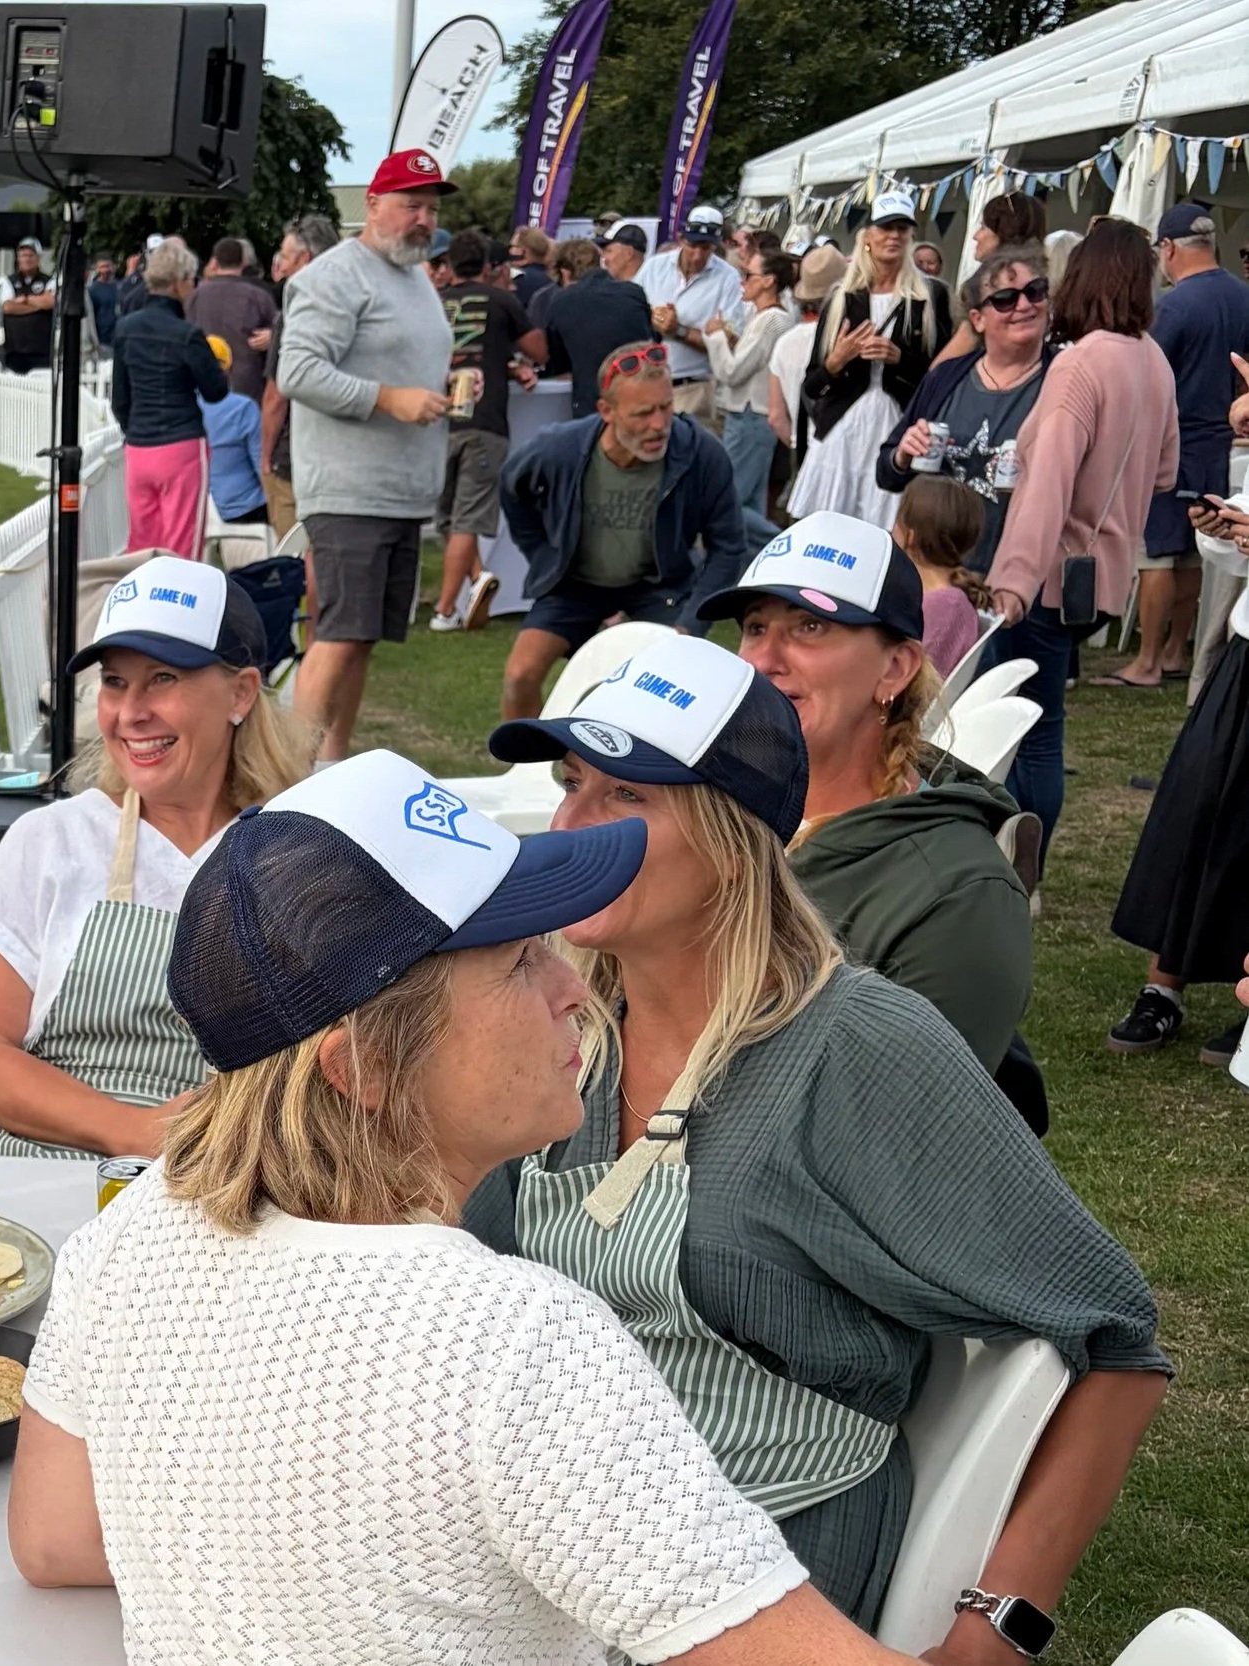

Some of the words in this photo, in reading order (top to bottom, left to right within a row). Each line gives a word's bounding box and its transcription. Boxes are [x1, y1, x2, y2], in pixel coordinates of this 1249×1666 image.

[427, 43, 490, 150] BEACH
[540, 48, 578, 153] TRAVEL
[678, 45, 712, 152] TRAVEL
[532, 157, 551, 197] OF
[671, 157, 686, 197] OF
[803, 543, 839, 563] GAME
[836, 552, 857, 570] ON
[149, 587, 181, 604] GAME
[180, 592, 198, 609] ON
[633, 671, 677, 699] GAME
[668, 688, 697, 710] ON
